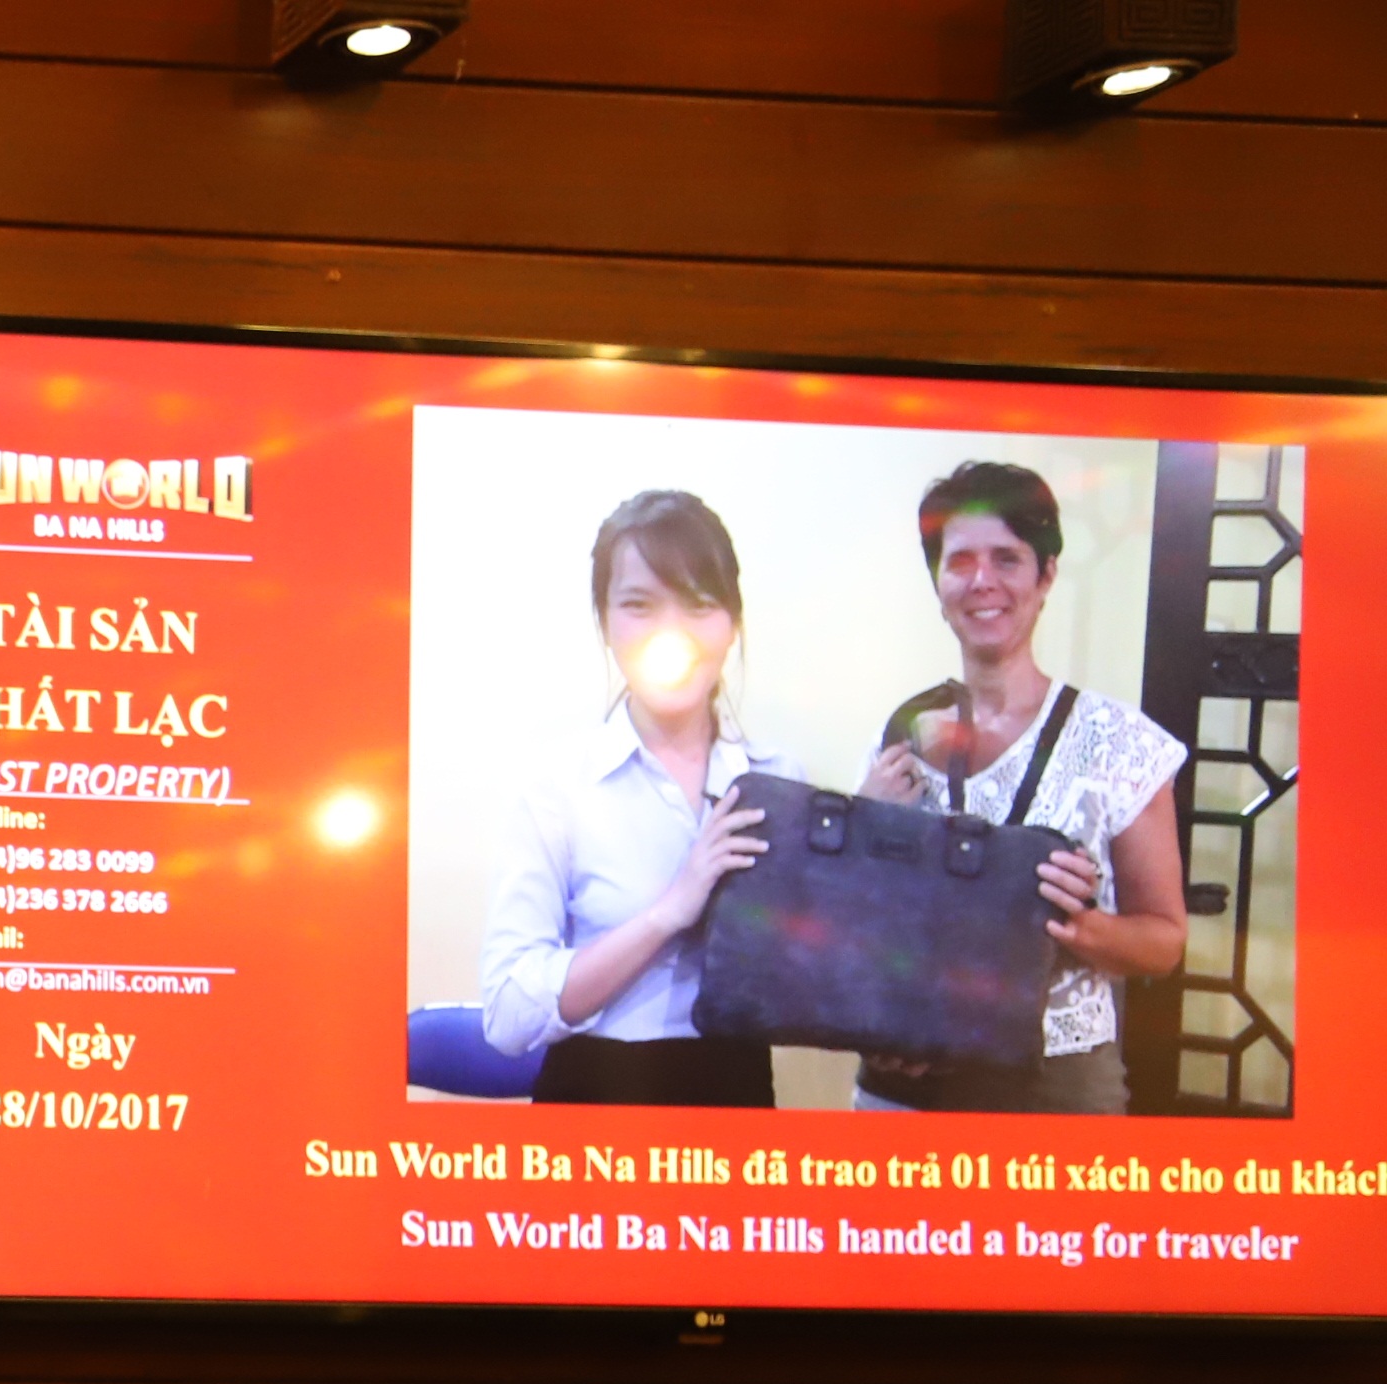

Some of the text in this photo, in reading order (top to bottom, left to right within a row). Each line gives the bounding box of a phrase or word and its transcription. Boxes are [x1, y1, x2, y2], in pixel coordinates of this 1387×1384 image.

[58, 455, 254, 522] WORLD
[33, 514, 165, 542] BA NA HILLS
[89, 596, 198, 654] SẢN
[113, 692, 227, 748] LẠC
[44, 762, 231, 807] PROPERTY)
[48, 848, 92, 872] 283
[96, 850, 155, 874] 0099
[61, 889, 105, 912] 378
[110, 891, 169, 914] 2666
[34, 1022, 136, 1070] Ngày
[305, 1139, 378, 1178] Sun
[389, 1142, 507, 1181] World
[521, 1144, 572, 1182] Ba
[583, 1146, 636, 1183] Na
[648, 1147, 731, 1185] Hills
[742, 1149, 789, 1186] đã
[800, 1155, 877, 1188] trao
[887, 1152, 941, 1188] trả
[951, 1153, 990, 1189] 01
[1005, 1153, 1055, 1191] túi
[1065, 1155, 1150, 1193] xách
[1159, 1157, 1224, 1194] cho
[1233, 1159, 1281, 1195] du
[401, 1210, 1299, 1266] Sun World Ba Na Hills handed a bag for traveler
